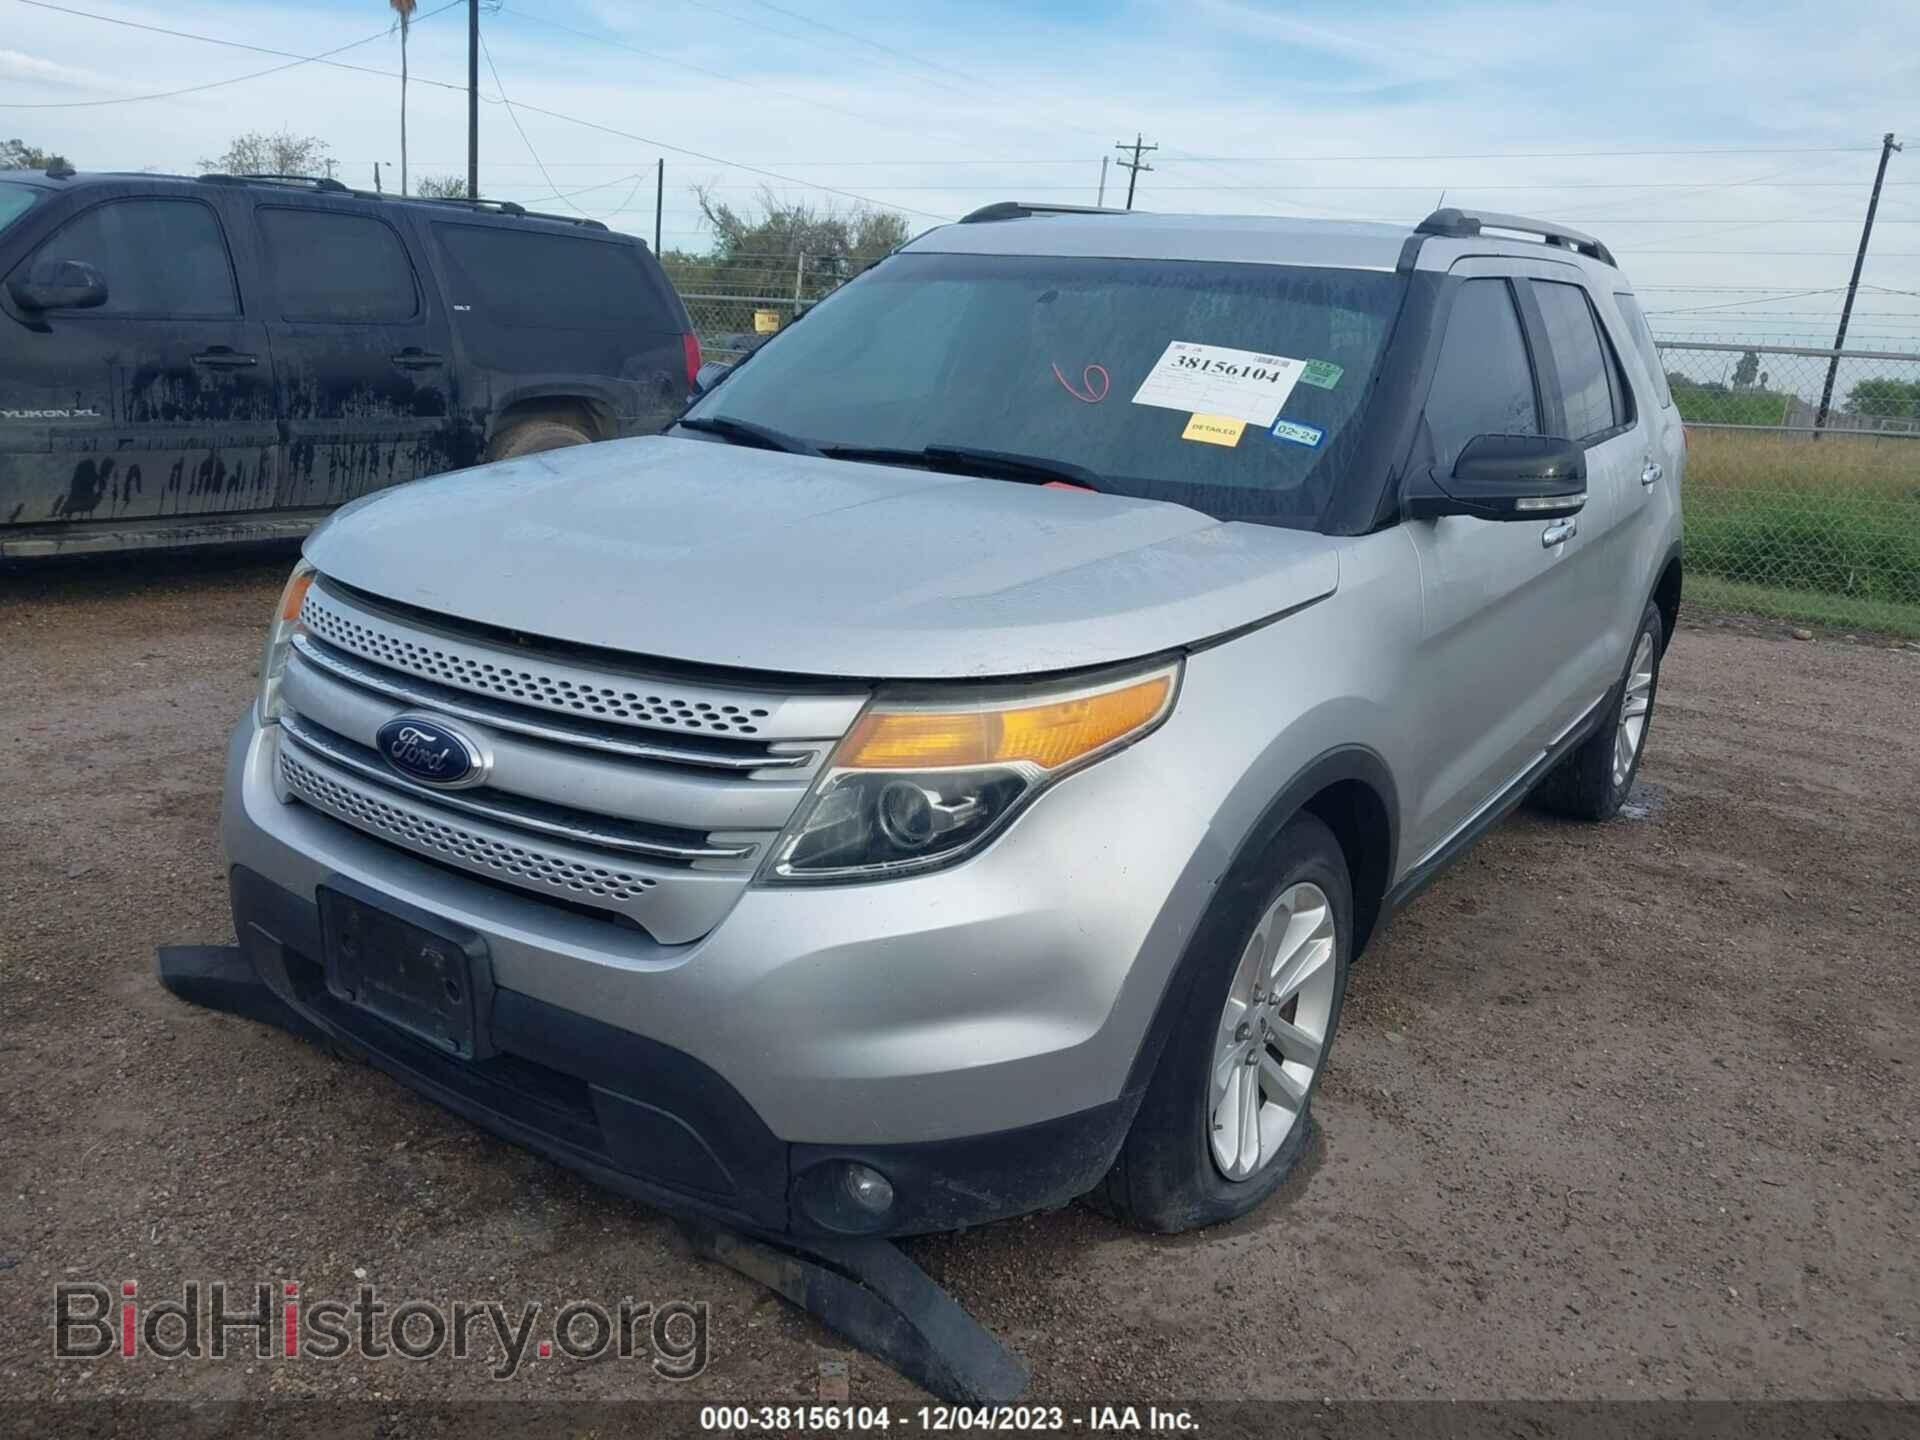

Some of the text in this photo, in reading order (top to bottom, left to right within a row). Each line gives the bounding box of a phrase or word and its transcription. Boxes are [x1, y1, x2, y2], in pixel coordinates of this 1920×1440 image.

[1171, 354, 1281, 384] 38156104
[0, 409, 101, 418] YUKON XL
[1191, 423, 1237, 437] DETAILED
[391, 726, 450, 771] Ford
